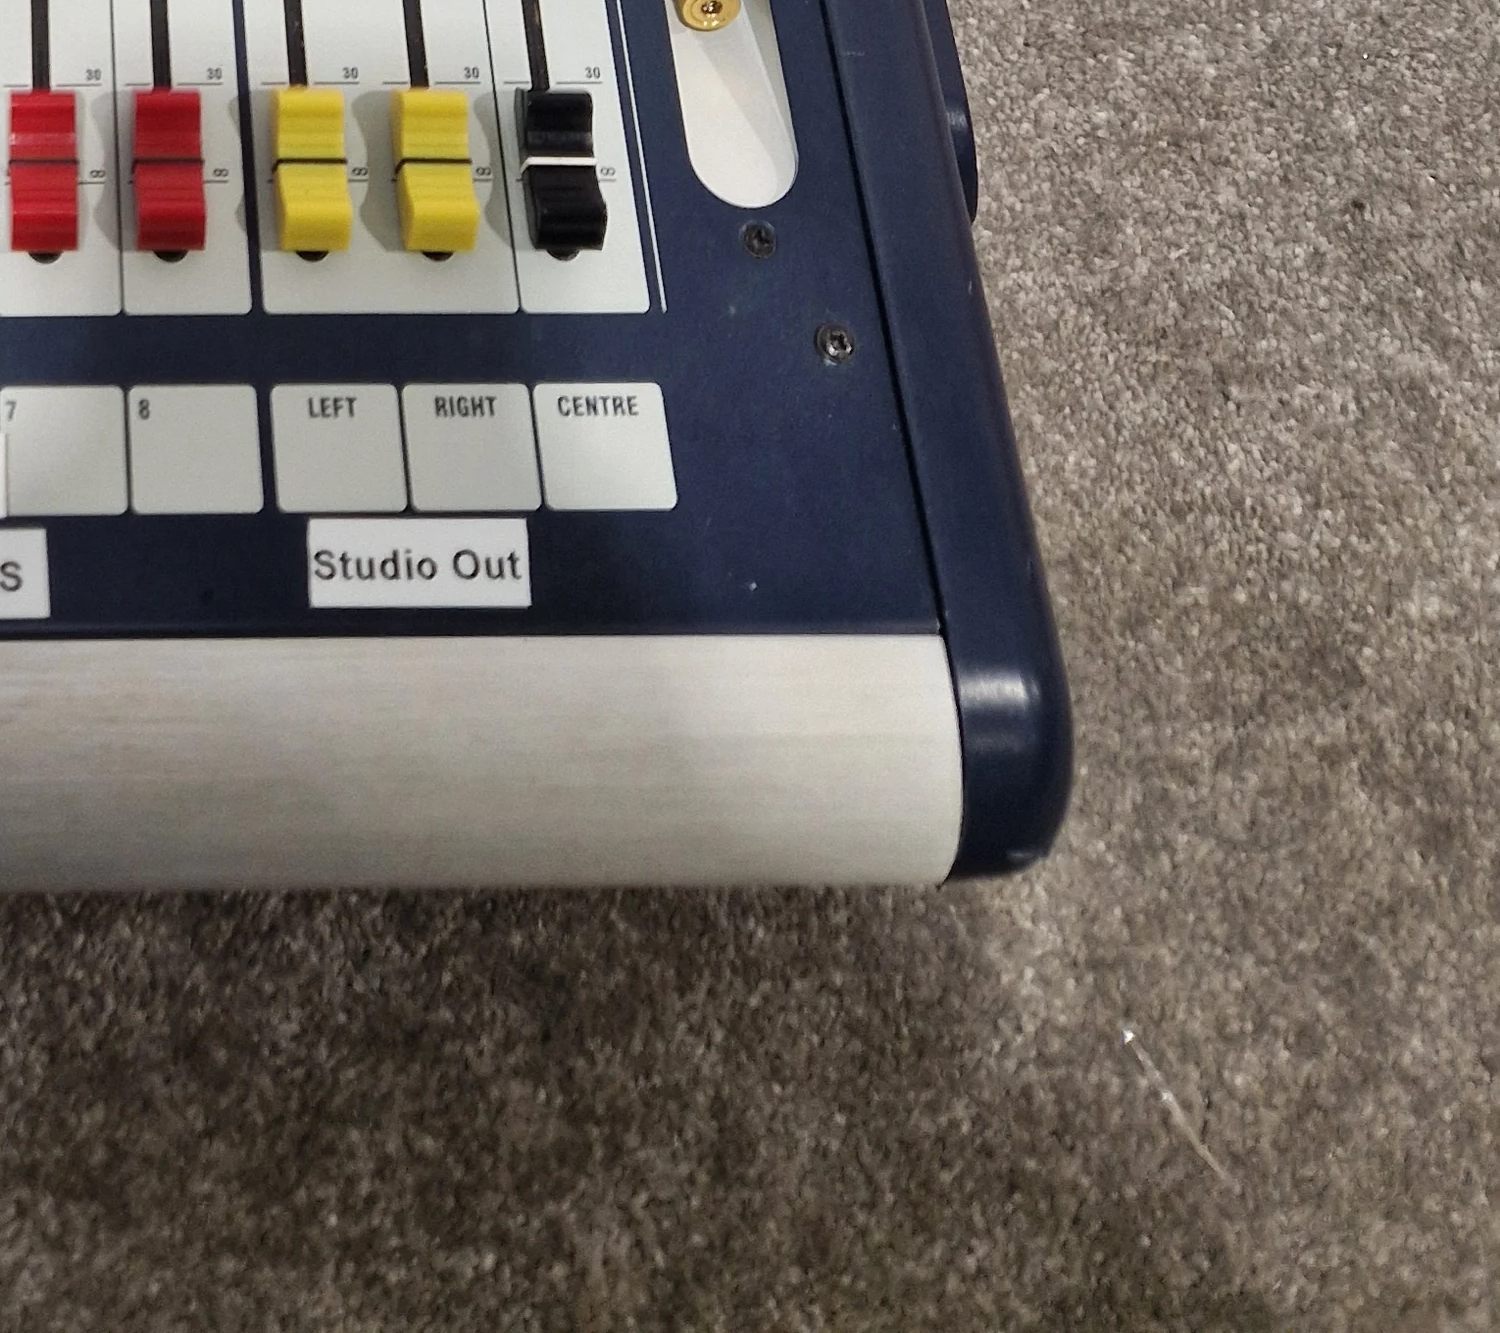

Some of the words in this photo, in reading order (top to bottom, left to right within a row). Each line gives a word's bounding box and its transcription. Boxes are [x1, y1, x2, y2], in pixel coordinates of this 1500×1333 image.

[584, 66, 601, 79] 30
[6, 401, 17, 421] 7
[138, 399, 150, 419] 8
[307, 398, 356, 418] LEFT
[434, 397, 498, 417] RIGHT
[558, 396, 639, 416] CENTRE
[314, 549, 437, 581] Studio
[453, 549, 522, 581] Out
